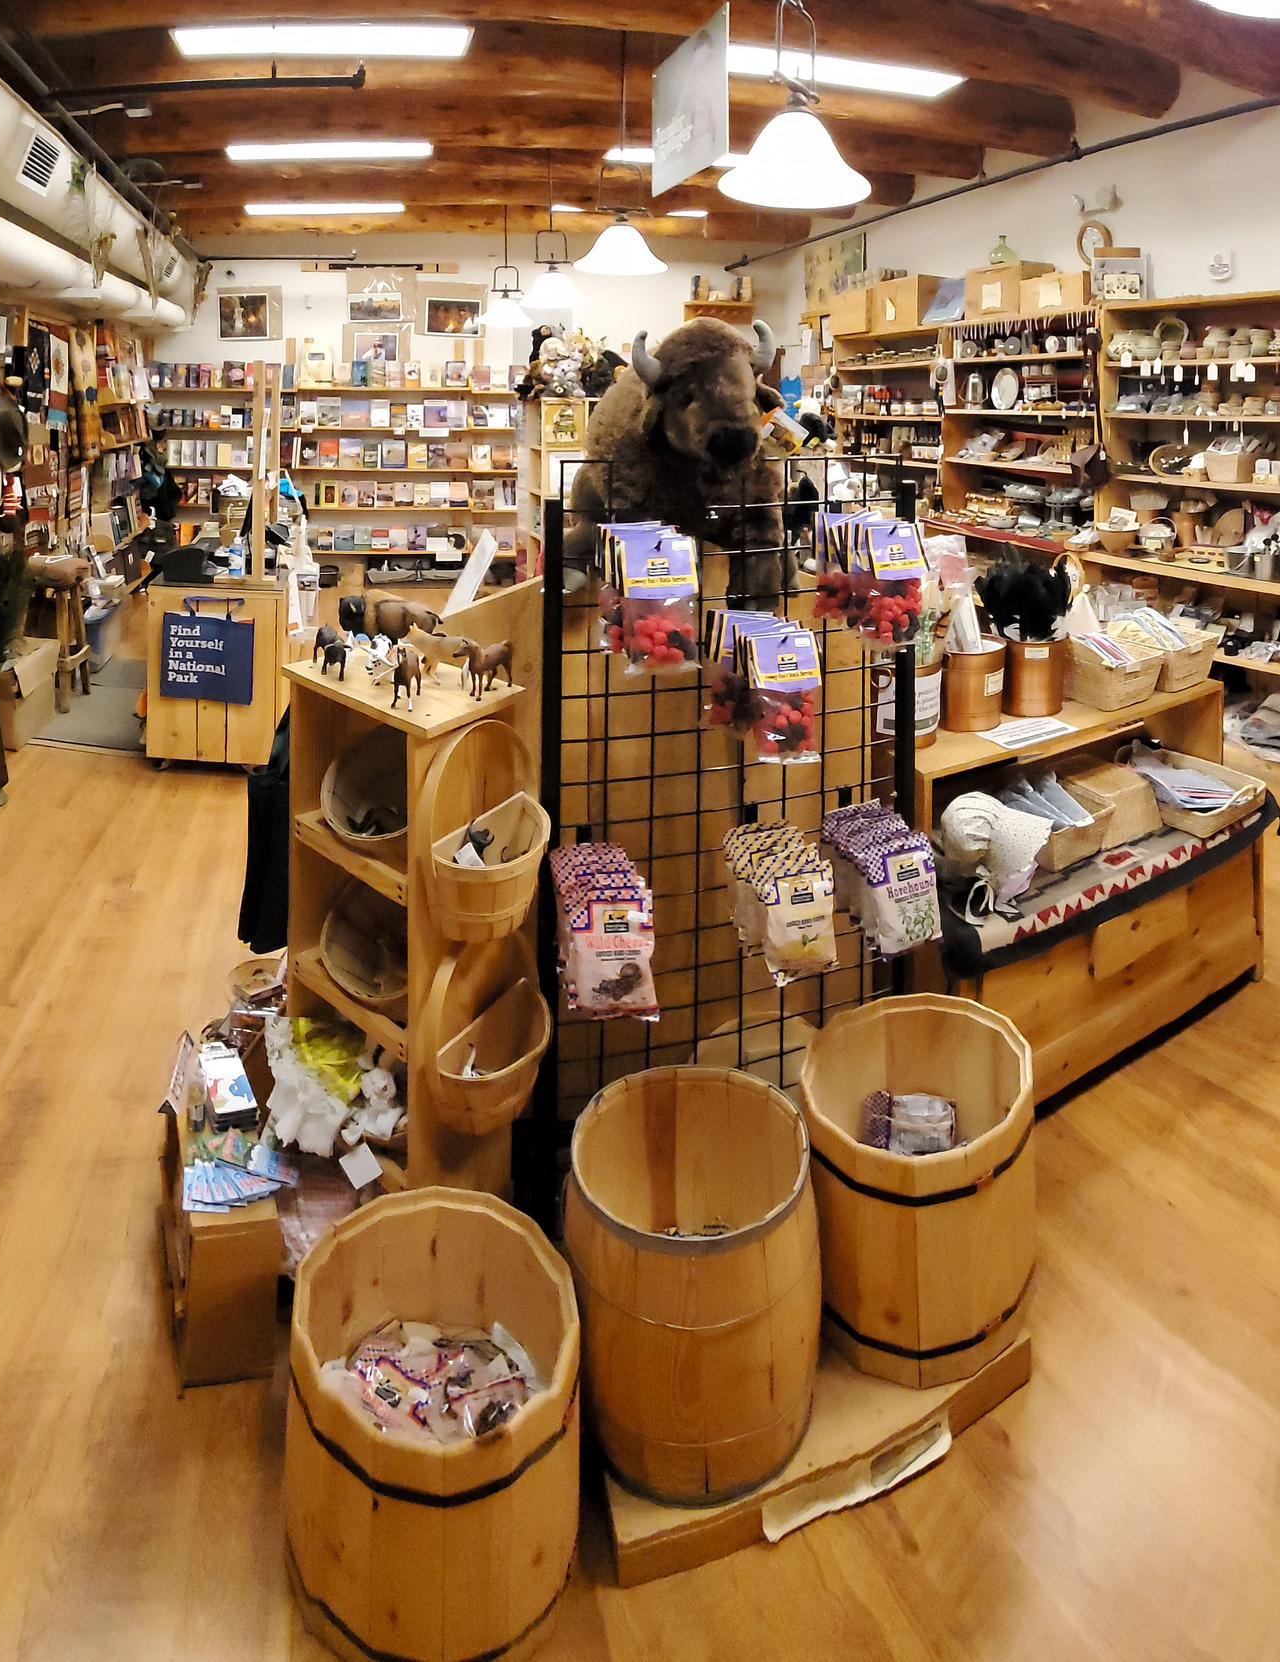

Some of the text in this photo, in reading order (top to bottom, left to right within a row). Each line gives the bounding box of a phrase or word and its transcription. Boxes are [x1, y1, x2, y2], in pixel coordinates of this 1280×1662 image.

[170, 625, 201, 637] Find
[169, 637, 225, 652] Yourself
[169, 648, 194, 659] in a
[168, 660, 226, 676] National
[167, 671, 199, 684] Park
[886, 875, 934, 899] Horehound
